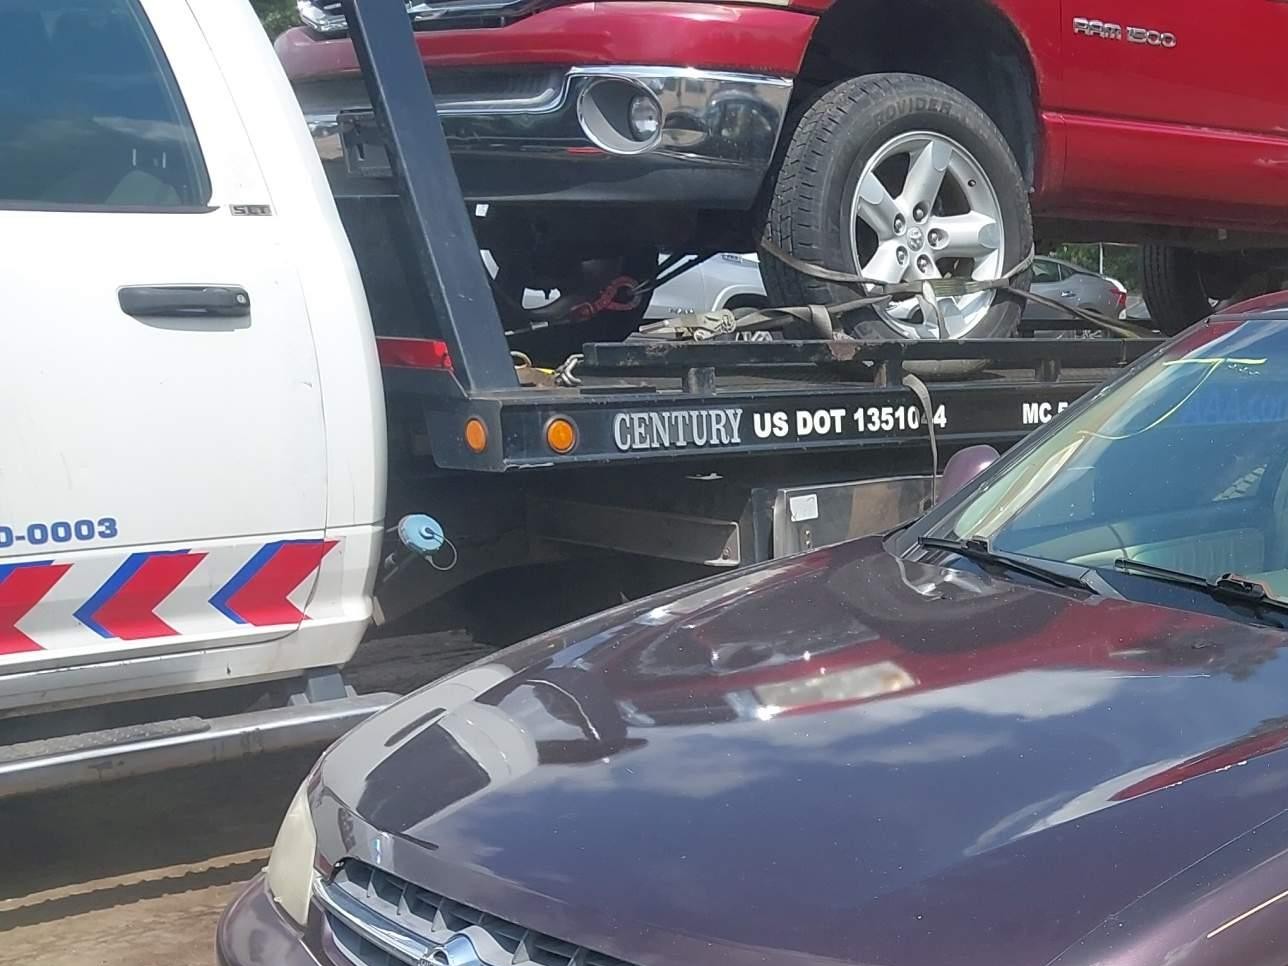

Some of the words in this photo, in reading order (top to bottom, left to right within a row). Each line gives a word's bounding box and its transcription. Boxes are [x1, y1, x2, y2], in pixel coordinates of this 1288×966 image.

[1073, 17, 1121, 40] RAM
[1126, 26, 1176, 48] 1500
[614, 408, 743, 451] CENTURY
[753, 412, 789, 438] US
[796, 409, 846, 436] DOT
[1022, 403, 1052, 424] MC
